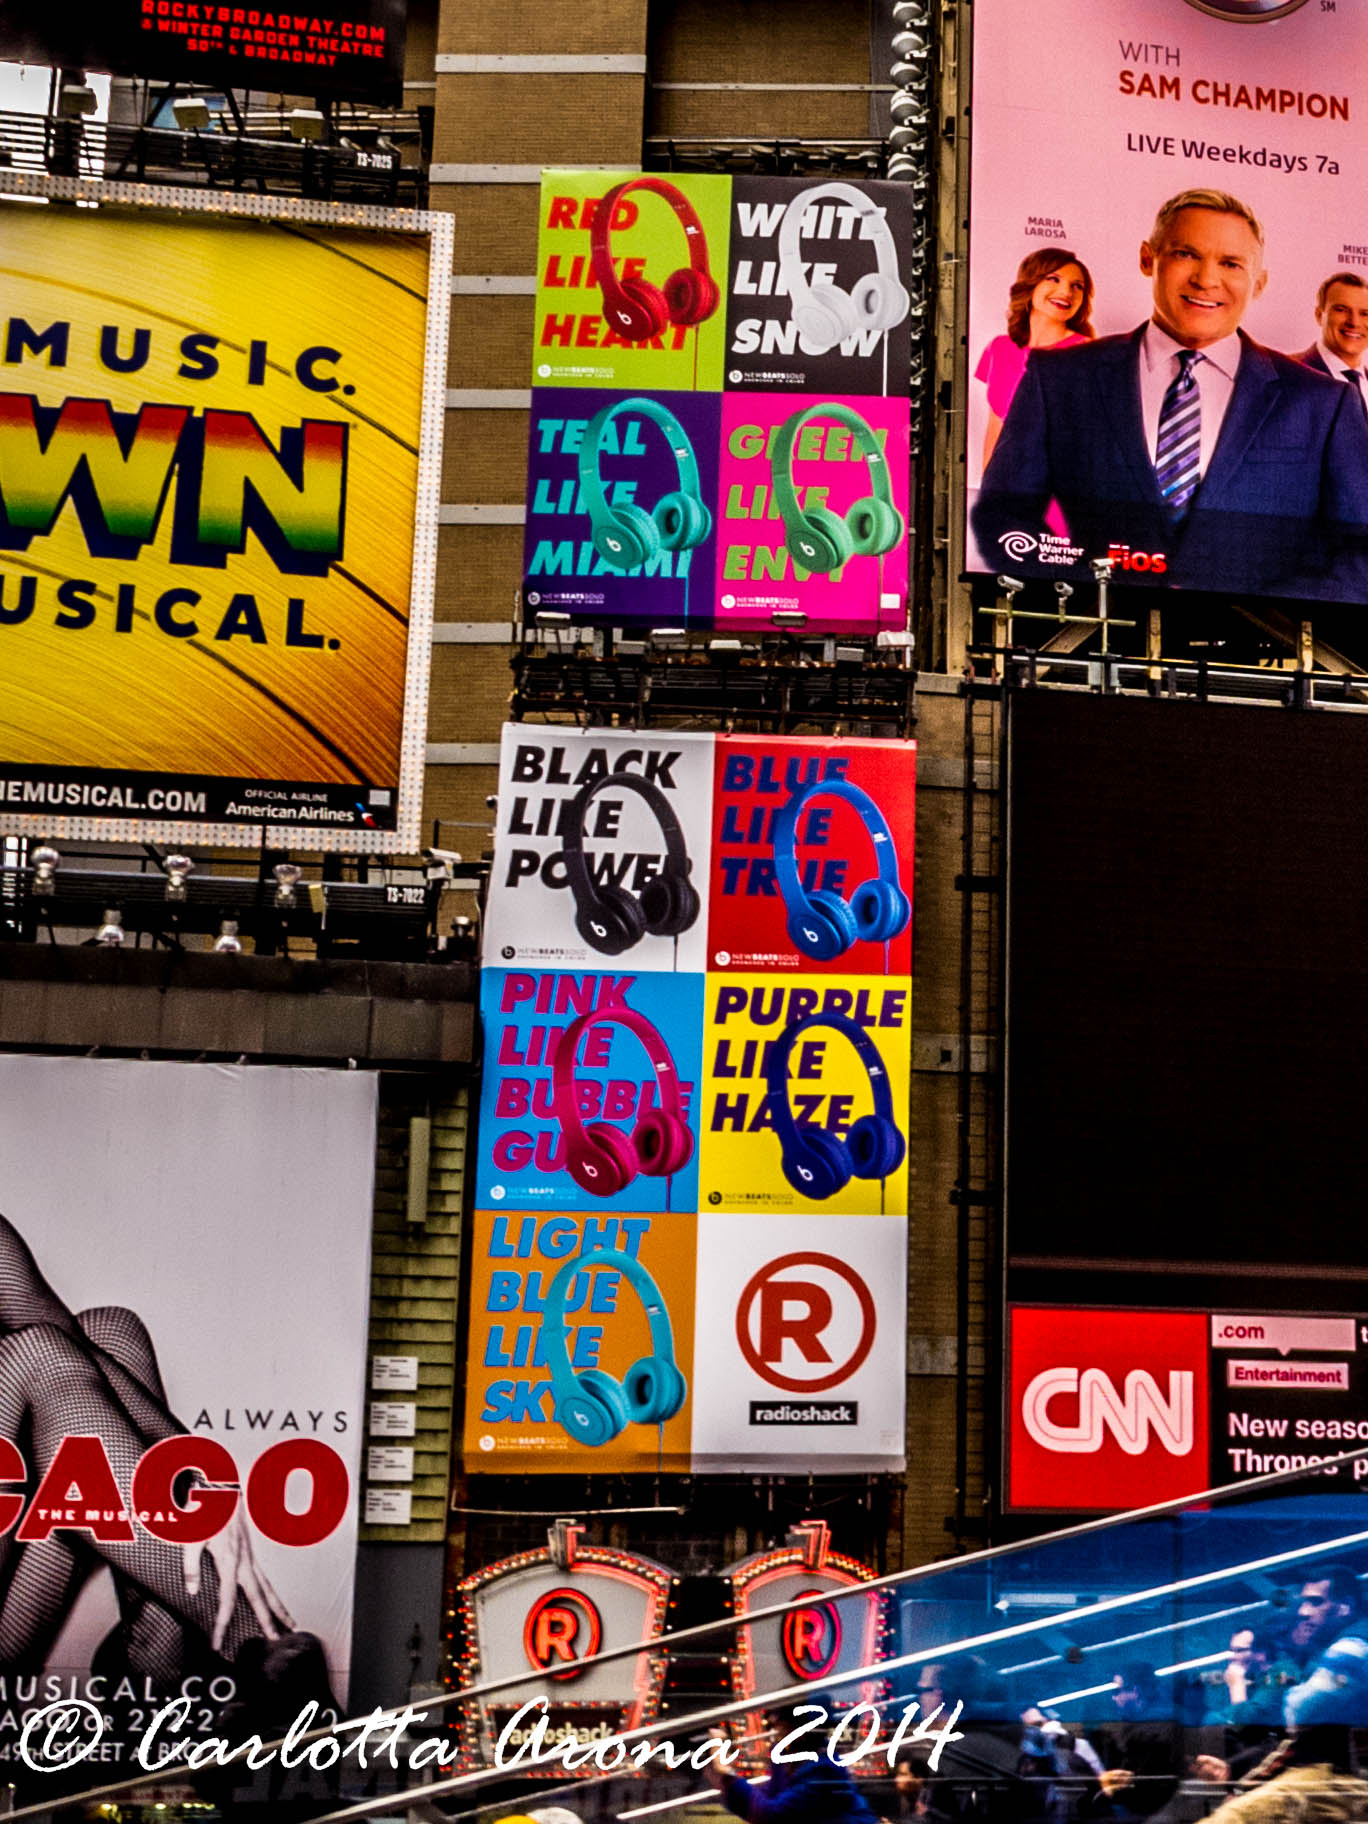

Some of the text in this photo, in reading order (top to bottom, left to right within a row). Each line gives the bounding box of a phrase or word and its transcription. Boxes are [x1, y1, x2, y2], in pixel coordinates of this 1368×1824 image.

[157, 18, 224, 39] WINTER
[229, 26, 300, 47] GARDEN
[306, 35, 385, 59] THEATRE
[244, 44, 337, 67] BROADWAY
[1118, 39, 1181, 67] WITH
[1118, 70, 1350, 122] SAM CHAMPION
[1126, 132, 1341, 176] LIVE Weekdays 7a
[547, 196, 639, 231] RED
[1027, 216, 1064, 228] MARIA
[1024, 226, 1067, 240] LAROSA
[1343, 243, 1368, 256] MIKE
[5, 316, 356, 397] MUSIC.
[537, 418, 647, 456] TEAL
[1038, 533, 1071, 546] Time
[1038, 542, 1085, 556] Warner
[1038, 552, 1075, 565] Cable
[511, 745, 683, 790] BLACK
[722, 754, 850, 793] BLUE
[244, 788, 328, 804] OFFICIAL AIRLINE
[225, 800, 355, 823] American Airlines
[500, 972, 637, 1016] PINK
[714, 985, 908, 1028] PURPLE
[495, 1077, 695, 1123] BUBBLE
[710, 1092, 855, 1134] HAZE
[492, 1129, 568, 1173] GU
[488, 1216, 652, 1260] LIGHT
[485, 1270, 622, 1314] BLUE
[1217, 1320, 1265, 1342] .com
[1234, 1365, 1343, 1386] Entertainment
[194, 1408, 348, 1433] ALWAYS
[755, 1405, 852, 1424] radioshack
[1022, 1365, 1195, 1457] CNN
[1228, 1412, 1289, 1439] New
[0, 1435, 349, 1547] AGO
[38, 1509, 178, 1523] THE MUSICAL
[0, 1676, 236, 1702] USICAL.CO
[505, 1722, 614, 1745] adoshack
